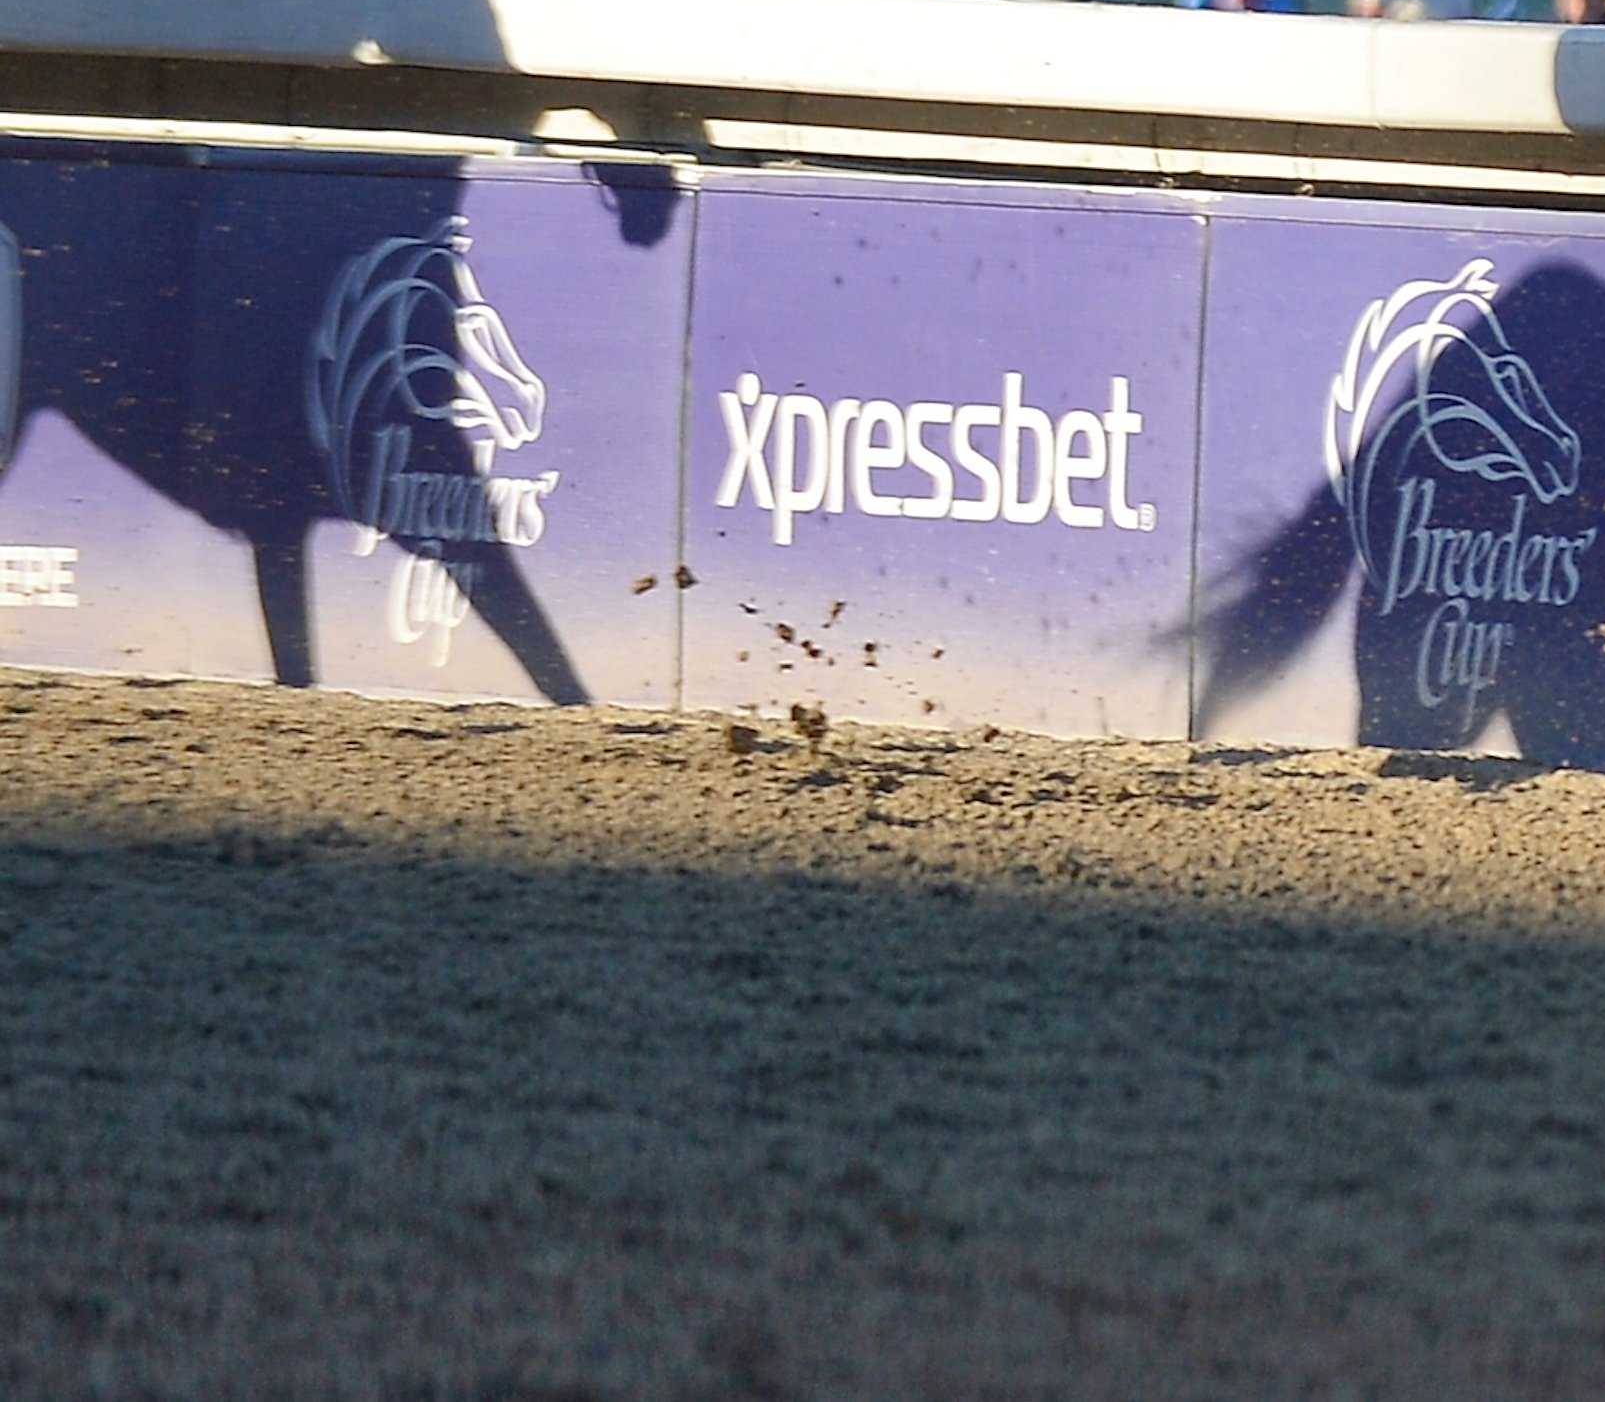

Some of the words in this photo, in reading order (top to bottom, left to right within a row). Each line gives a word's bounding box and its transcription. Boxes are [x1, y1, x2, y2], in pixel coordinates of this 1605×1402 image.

[715, 372, 1143, 546] xpressbet
[387, 539, 474, 667] Cup
[1416, 598, 1502, 734] Cup
